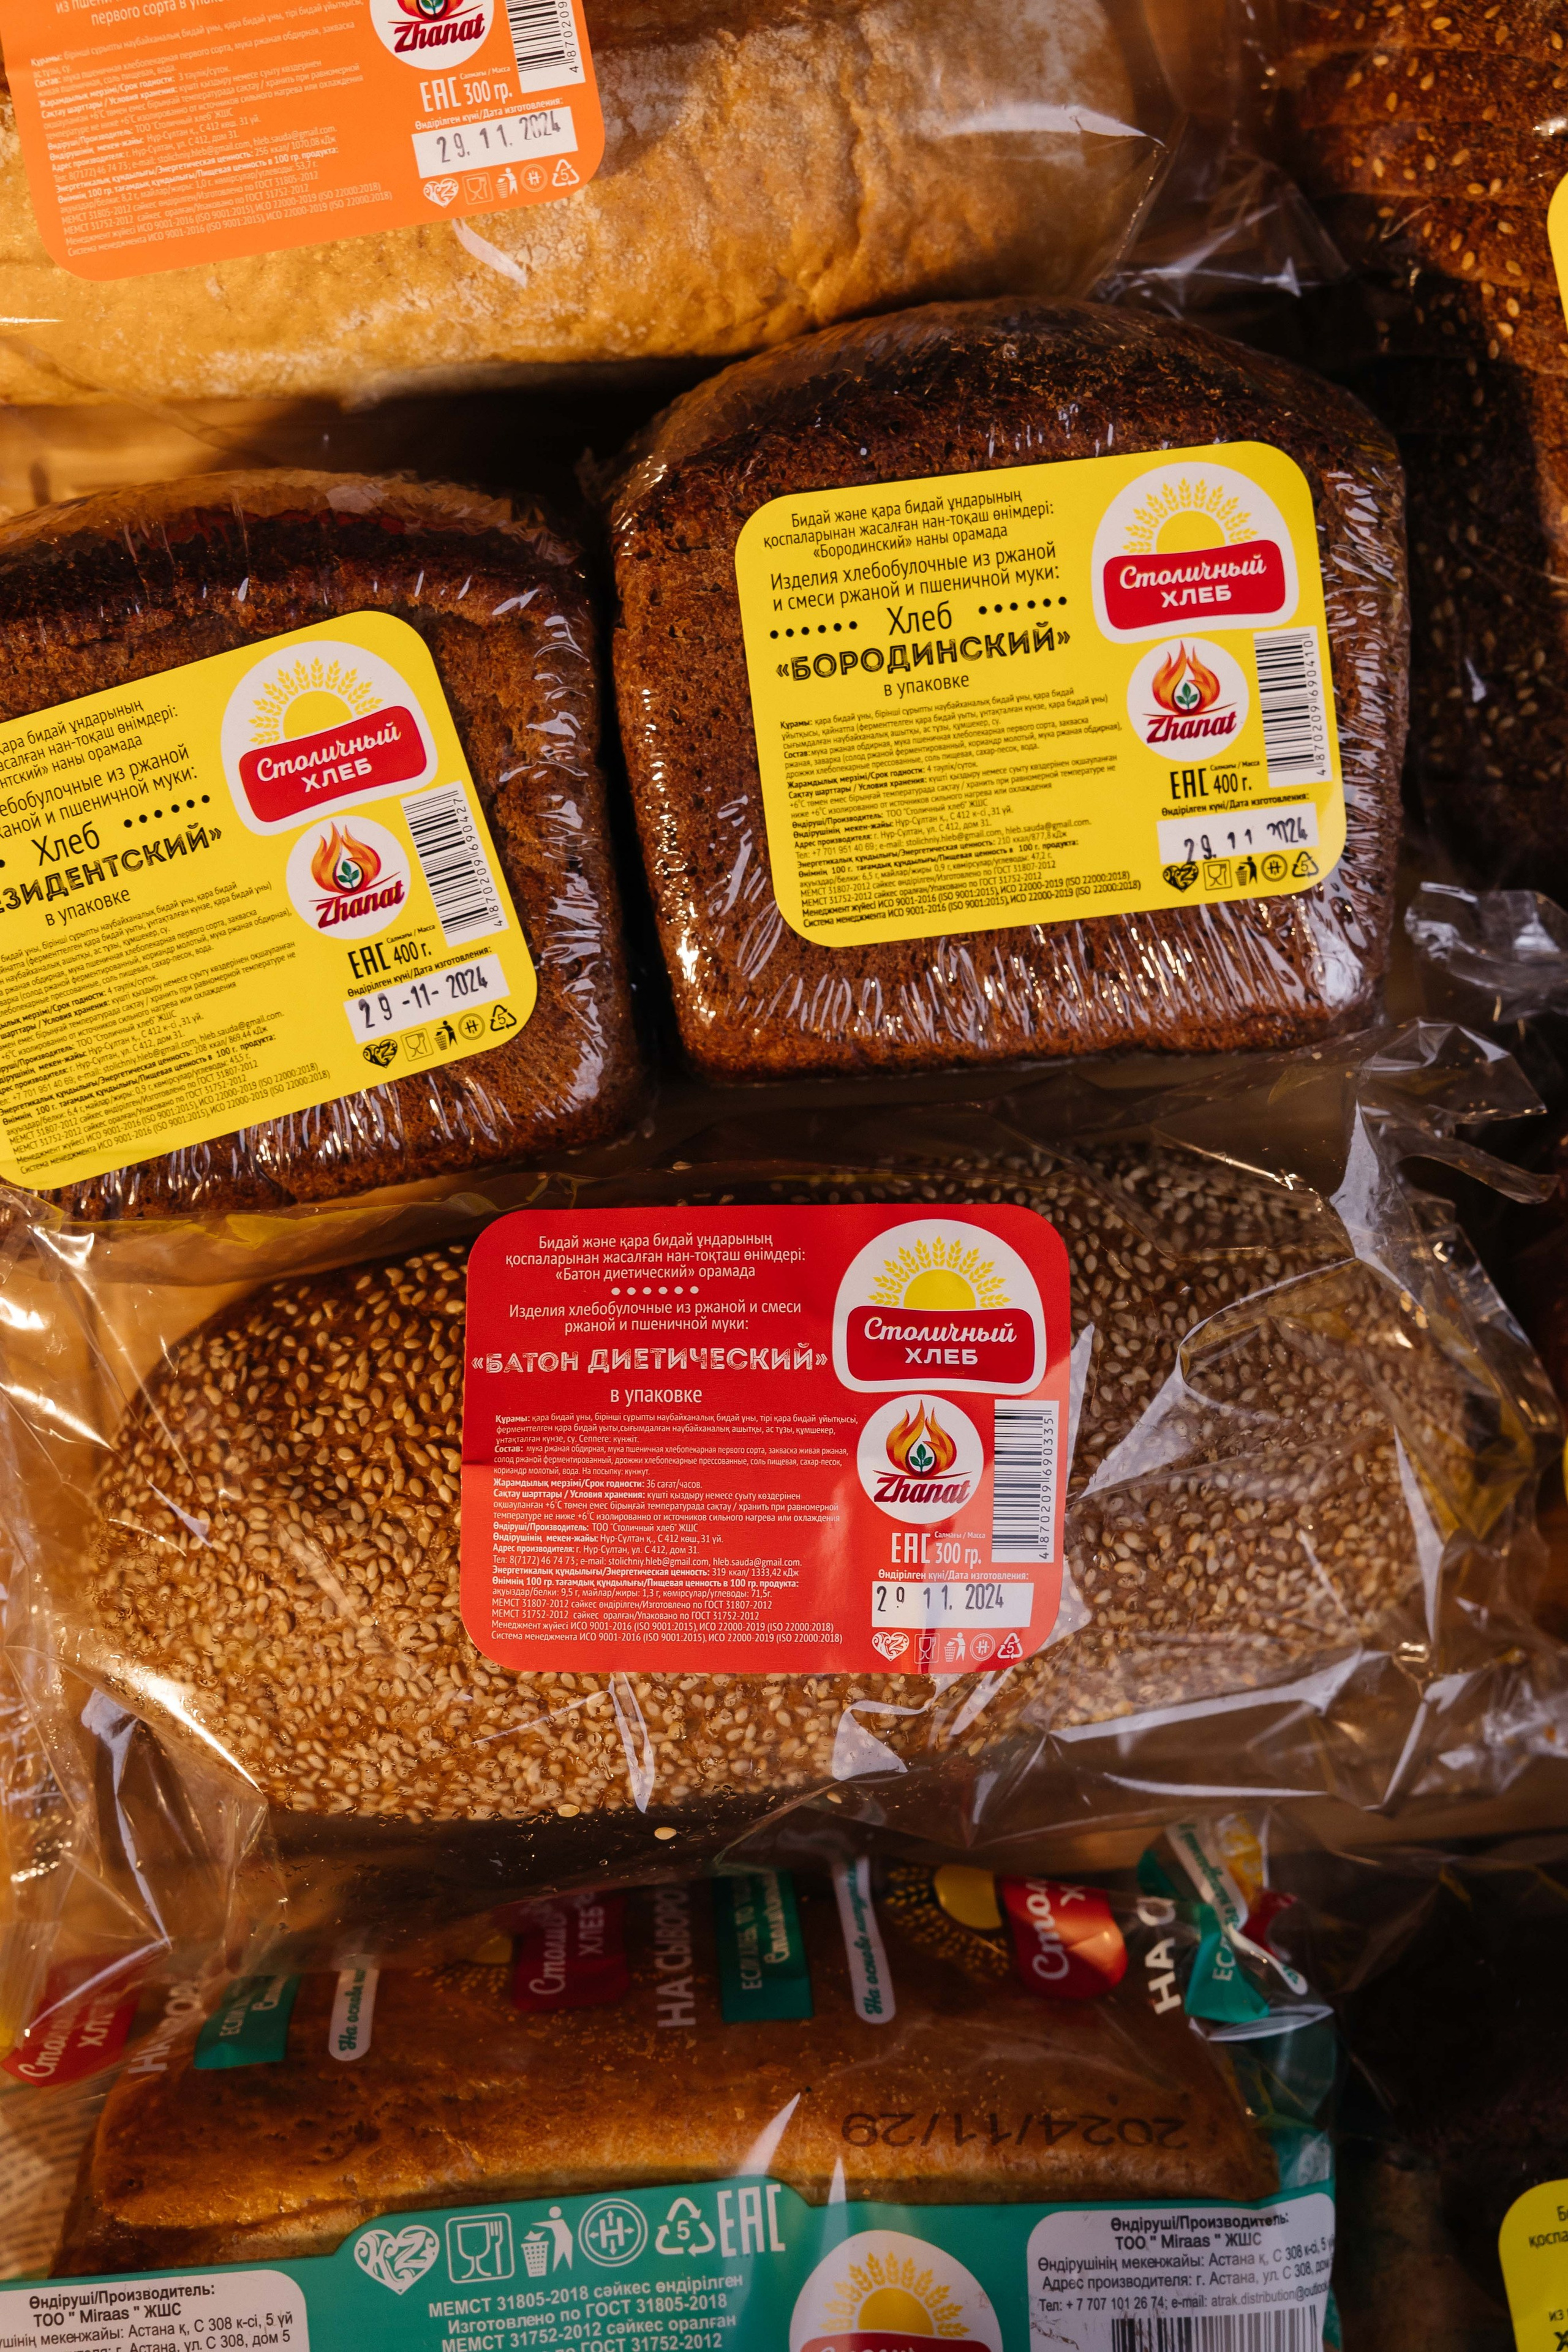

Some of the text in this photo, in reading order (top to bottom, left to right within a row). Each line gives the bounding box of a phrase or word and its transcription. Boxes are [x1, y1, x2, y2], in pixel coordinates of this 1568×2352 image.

[91, 6, 140, 26] первого
[142, 0, 176, 17] сорта
[178, 0, 186, 9] в
[391, 14, 488, 53] Zhanat
[463, 80, 513, 105] 300 гр.
[518, 110, 562, 140] 2024
[791, 490, 1022, 527] Бидай және қара бидай ұндарының
[763, 503, 1054, 549] қоспаларынан жасалған нан-тоқаш өнімдері:
[813, 526, 1007, 559] «Бородинский» наны орамада
[771, 540, 1055, 591] Изделия хлебобулочные из ржаной
[1119, 554, 1267, 589] Столичный
[773, 565, 1059, 611] и смеси ржаной и пшеничной муки:
[1161, 584, 1231, 608] ХЛЕБ
[886, 600, 952, 635] Хлеб
[775, 621, 1070, 681] «БОРОДИНСКИЙ»
[883, 675, 969, 699] в упаковке
[26, 720, 67, 744] бидай
[68, 700, 144, 734] ұндарының
[47, 726, 115, 755] нан-тоқаш
[117, 707, 178, 733] өнімдері:
[1145, 710, 1238, 743] Zhanat
[51, 753, 85, 772] наны
[88, 736, 142, 761] орамада
[257, 722, 401, 781] Столичный
[0, 743, 189, 816] ебобулочные из ржаной
[301, 757, 372, 793] ХЛЕБ
[1213, 772, 1251, 793] 400 г.
[44, 811, 56, 824] и
[59, 777, 149, 820] пшеничной
[152, 766, 197, 791] муки:
[31, 820, 99, 866] Хлеб
[45, 889, 130, 926] в упаковке
[313, 883, 408, 927] Zhanat
[393, 941, 431, 964] 400 г.
[445, 966, 489, 998] 2024
[539, 1234, 578, 1251] Бидай
[653, 1232, 693, 1248] бидай
[696, 1234, 773, 1248] ұндарының
[505, 1254, 598, 1267] қоспаларынан
[556, 1264, 755, 1281] «Батон диетический» орамада
[510, 1298, 801, 1320] Изделия хлебобулочные из ржаной и смеси
[565, 1316, 748, 1335] ржаной и пшеничной муки:
[864, 1316, 1017, 1342] Столичный
[471, 1342, 827, 1373] «БАТОН ДИЕТИЧЕСКИЙ»
[905, 1347, 978, 1365] ХЛЕБ
[610, 1389, 702, 1407] в упаковке
[874, 1477, 971, 1504] Zhanat
[935, 1542, 981, 1569] 300 гр.
[878, 1569, 925, 1581] Өндірілген
[929, 1569, 968, 1581] күні/Дата
[965, 1583, 1004, 1610] 2024
[656, 1976, 696, 2028] НА
[842, 2113, 1188, 2150] 2024/11/29
[1111, 2212, 1289, 2234] Өндіруші/Производитель:
[1114, 2231, 1261, 2250] ТОО Miraas ЖШС
[29, 2285, 214, 2310] Өндіруші/Производитель:
[429, 2269, 742, 2317] МЕМСТ 31805-2018 сәйкес өндірілген
[33, 2302, 181, 2327] ТОО Miraas ЖШС
[448, 2293, 729, 2334] Изготовлено по ГОСТ 31805-2018
[442, 2310, 737, 2351] МЕМСТ 31752-2012 сәйкес оралған
